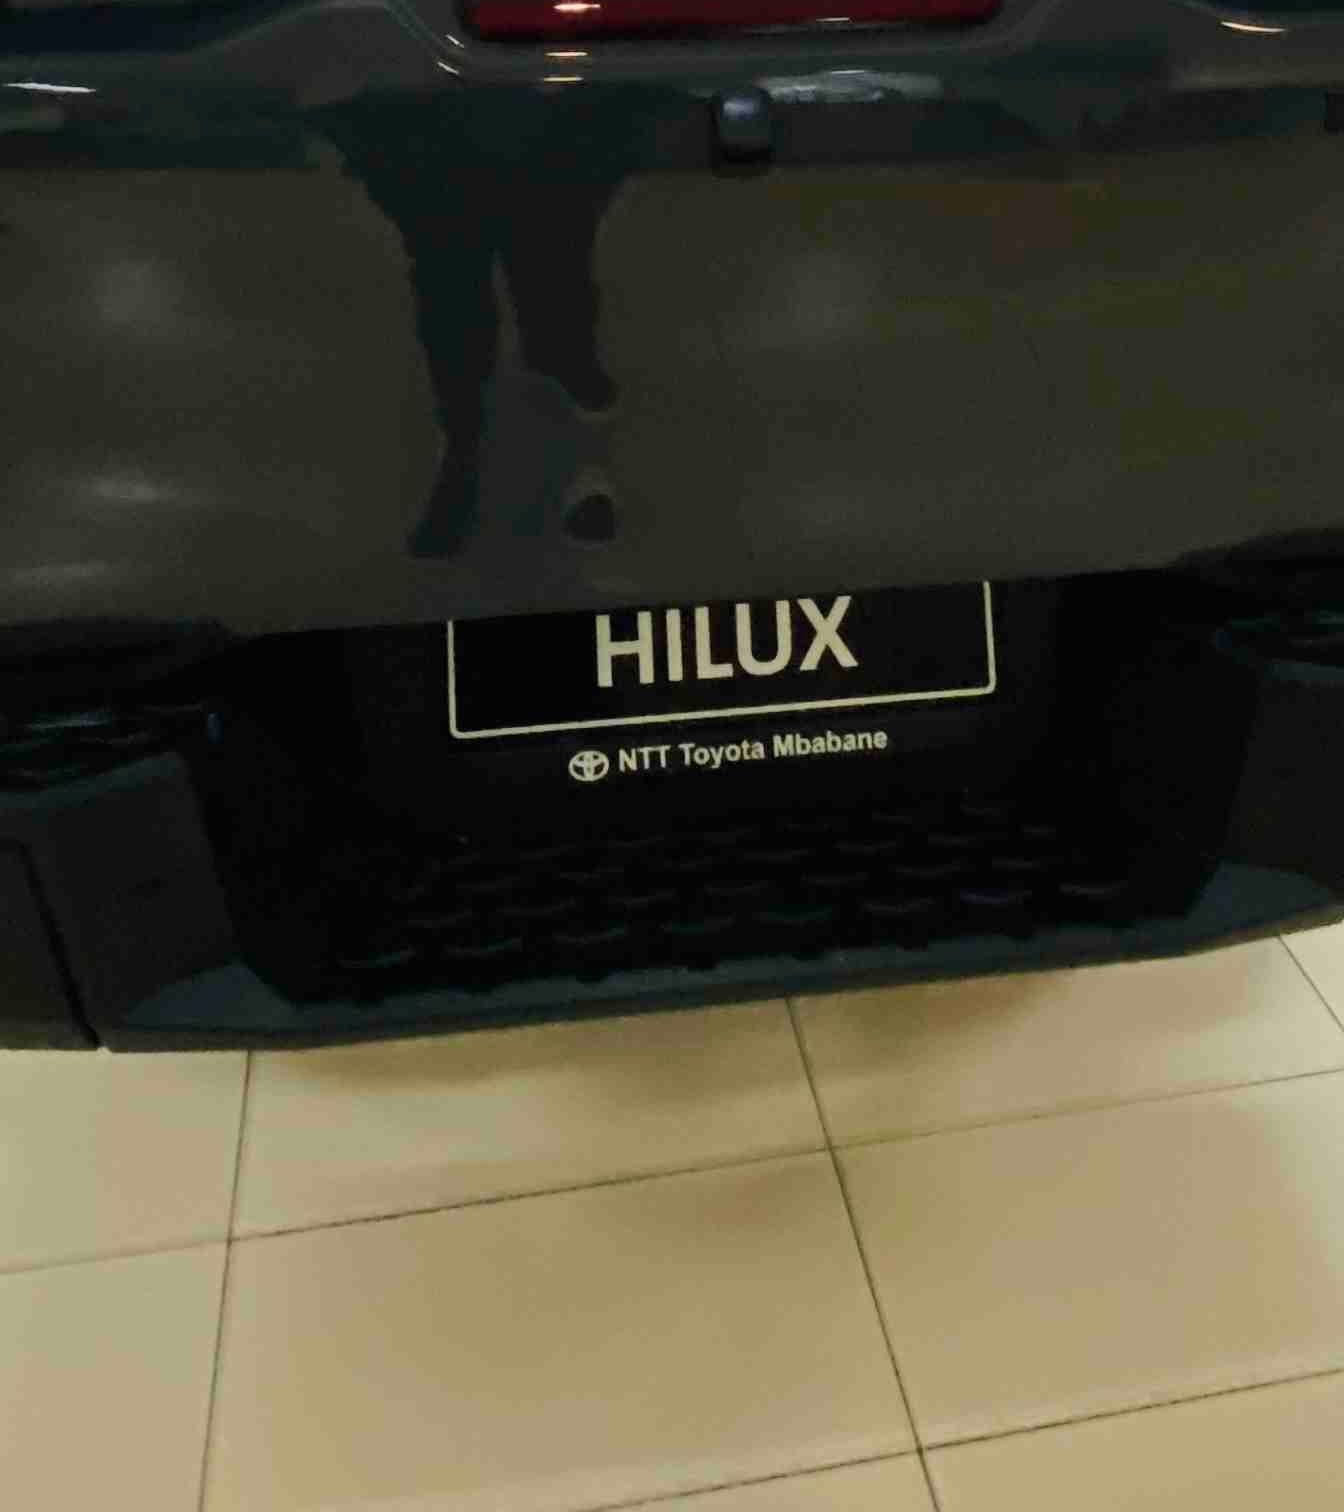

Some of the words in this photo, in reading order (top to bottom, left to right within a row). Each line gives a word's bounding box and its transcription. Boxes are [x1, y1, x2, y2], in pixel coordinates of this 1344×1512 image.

[595, 595, 859, 688] HILUX
[618, 744, 672, 773] NTT
[677, 739, 766, 769] Toyota
[772, 730, 888, 758] Mbabane
